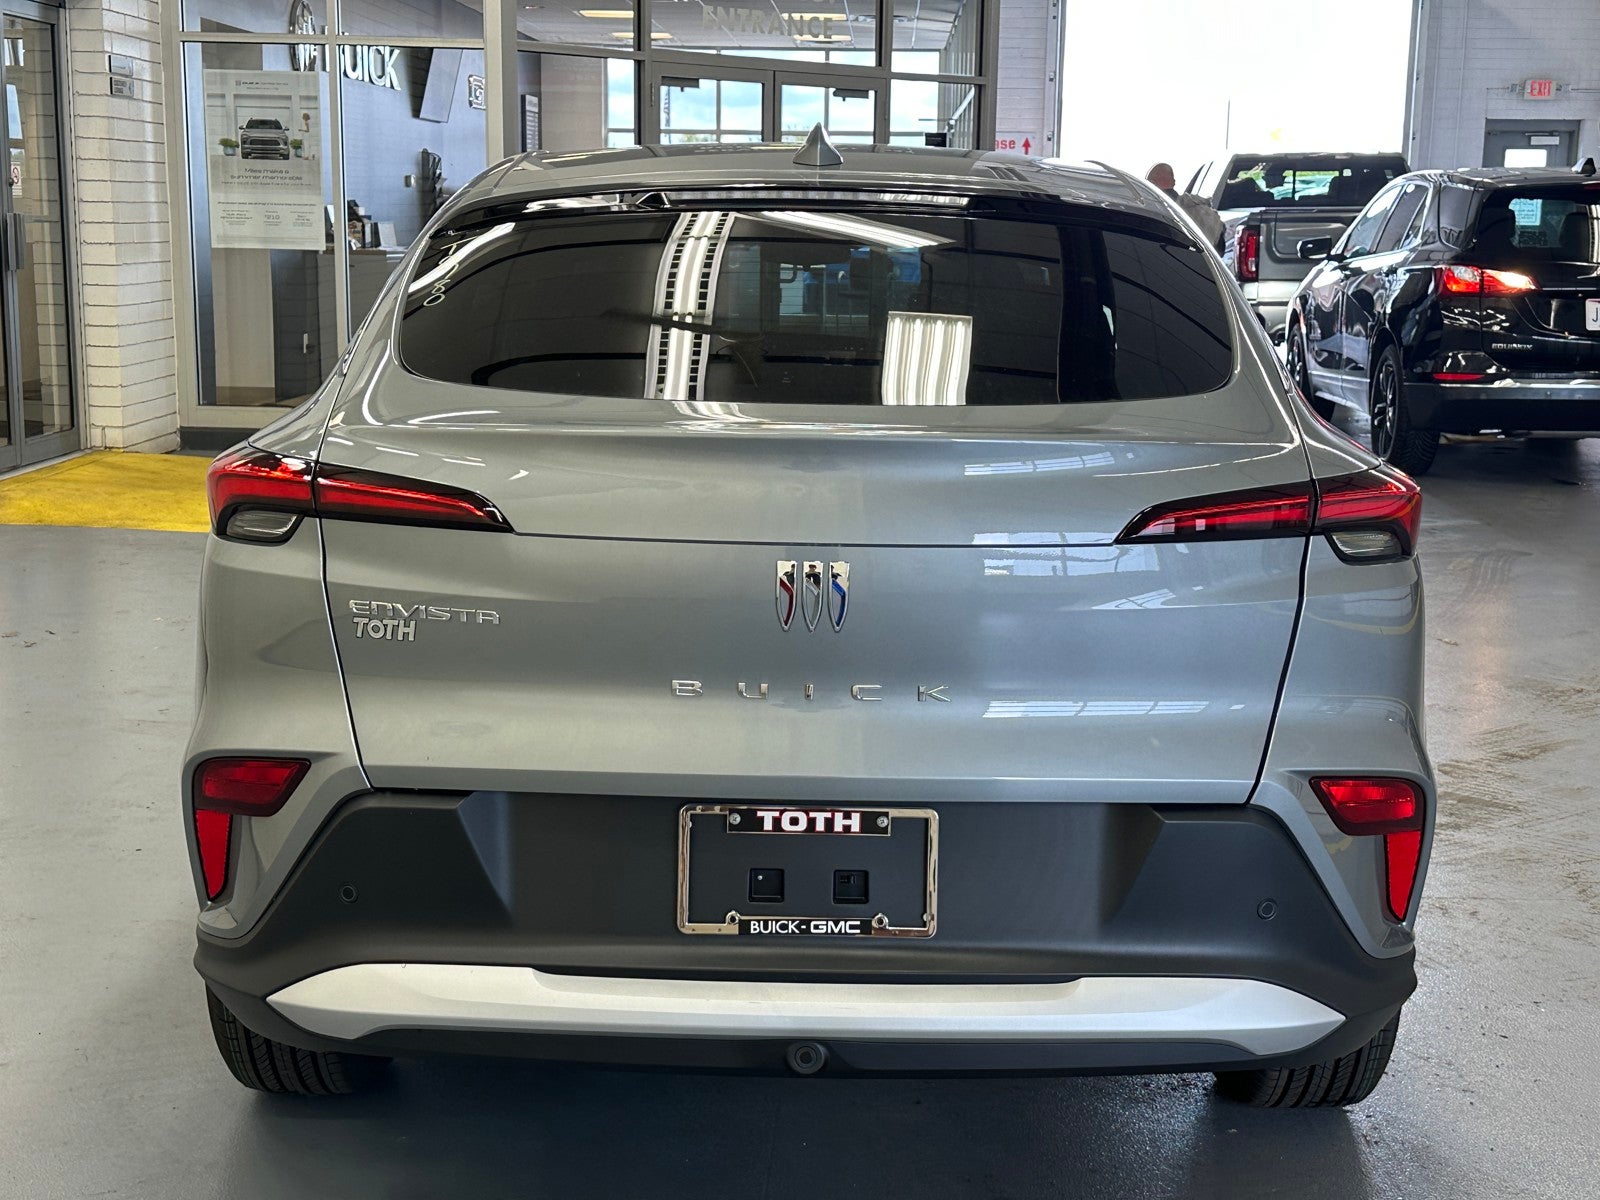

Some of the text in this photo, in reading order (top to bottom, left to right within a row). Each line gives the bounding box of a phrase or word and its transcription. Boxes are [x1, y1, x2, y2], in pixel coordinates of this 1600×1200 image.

[702, 5, 834, 39] ENTRANCE
[1530, 80, 1552, 97] EXIT
[1491, 342, 1533, 351] EQUINOX
[349, 599, 500, 625] ENVISTA
[353, 617, 417, 642] TOTH
[671, 680, 951, 702] BUICK
[757, 811, 862, 832] TOTH
